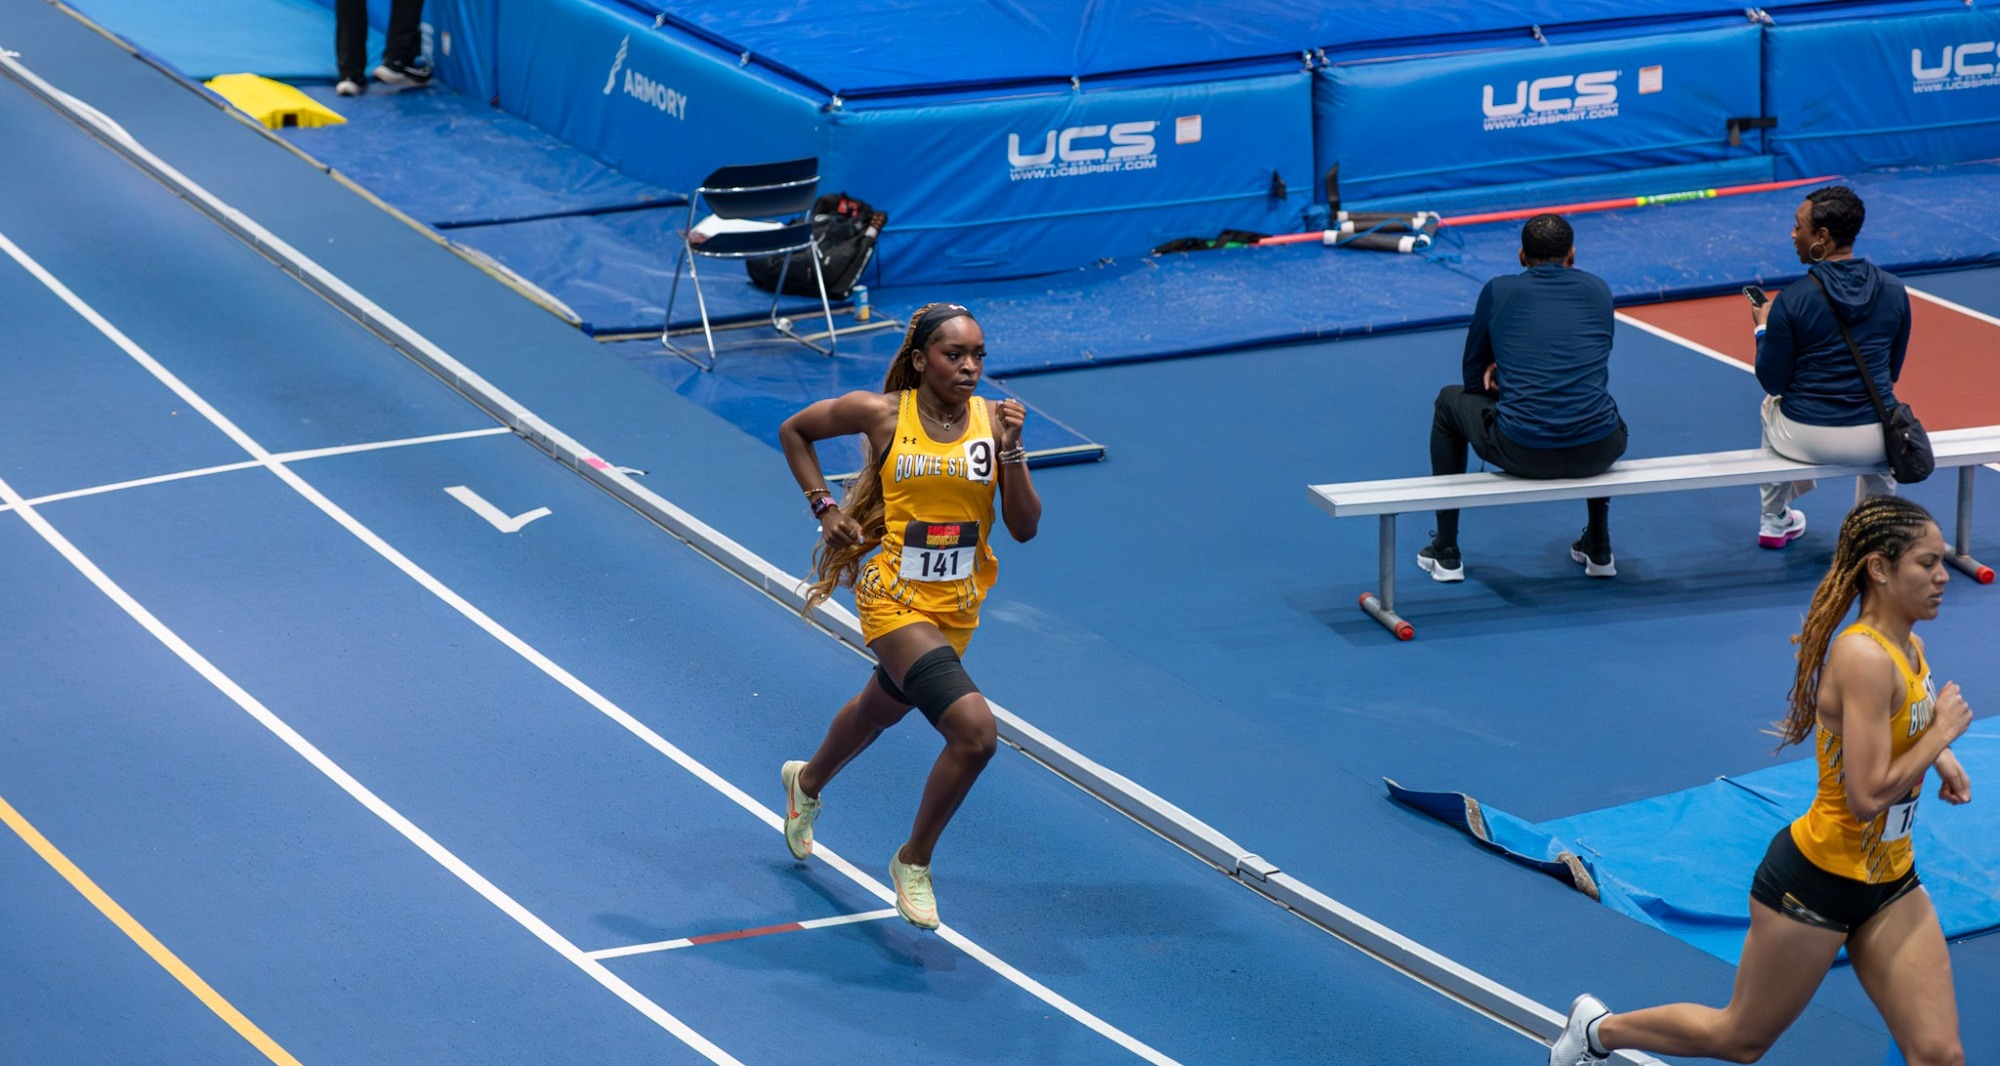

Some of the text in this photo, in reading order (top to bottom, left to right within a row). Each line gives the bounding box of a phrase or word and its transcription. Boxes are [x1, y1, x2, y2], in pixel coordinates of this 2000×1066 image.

[1911, 41, 2000, 80] UC
[623, 68, 687, 121] ARMORY
[1482, 70, 1618, 117] UCS
[1007, 121, 1156, 167] UCS
[1010, 160, 1157, 181] WWW.UCSSPIRIT.COM
[895, 454, 942, 483] BOWIE
[969, 441, 991, 477] 9
[926, 534, 960, 546] SHOWCASE
[920, 550, 960, 577] 141
